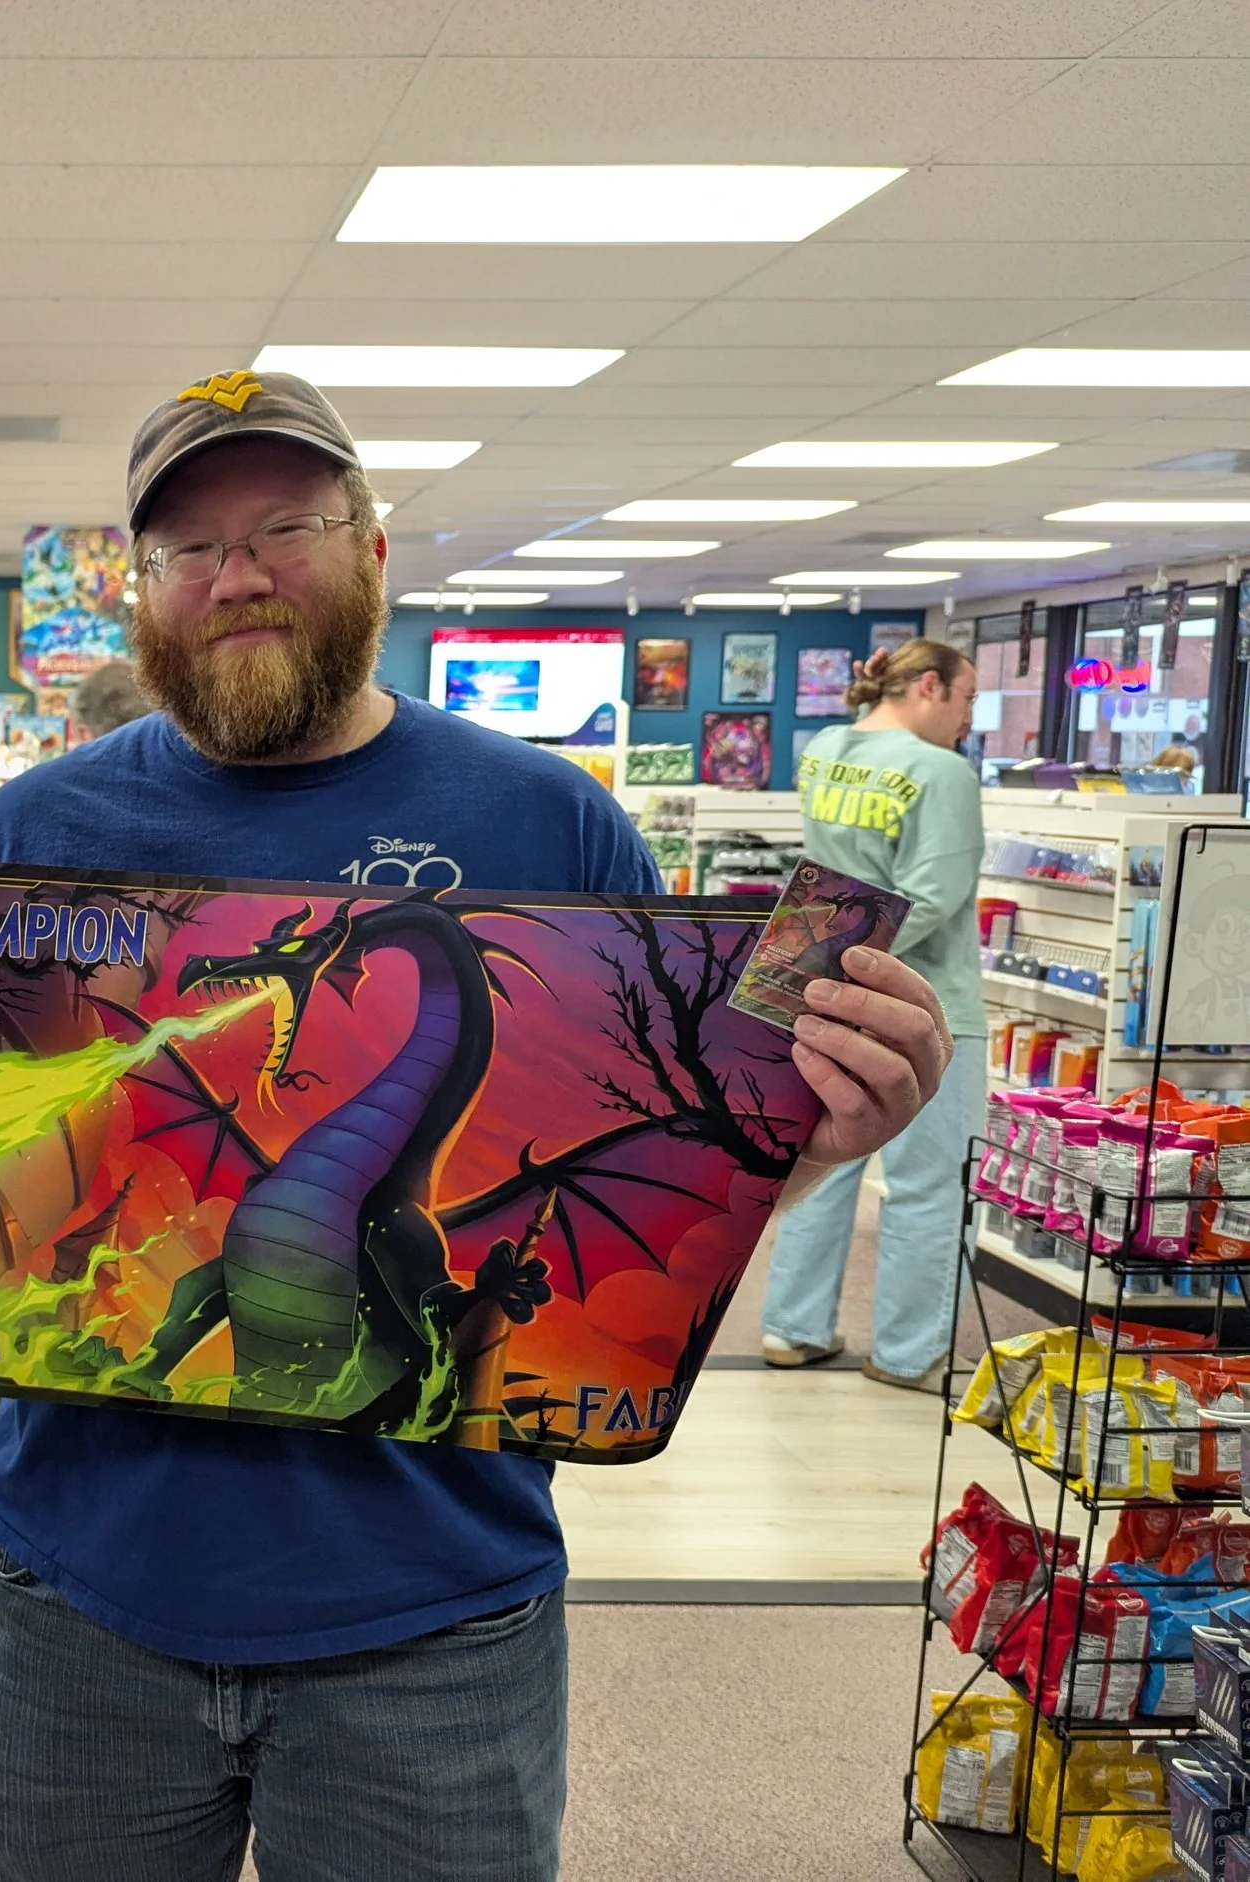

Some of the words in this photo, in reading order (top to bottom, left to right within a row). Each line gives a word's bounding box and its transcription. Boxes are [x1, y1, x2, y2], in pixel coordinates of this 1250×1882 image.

[811, 782, 907, 838] MORE
[367, 836, 436, 857] Disney
[575, 1383, 693, 1433] FAB
